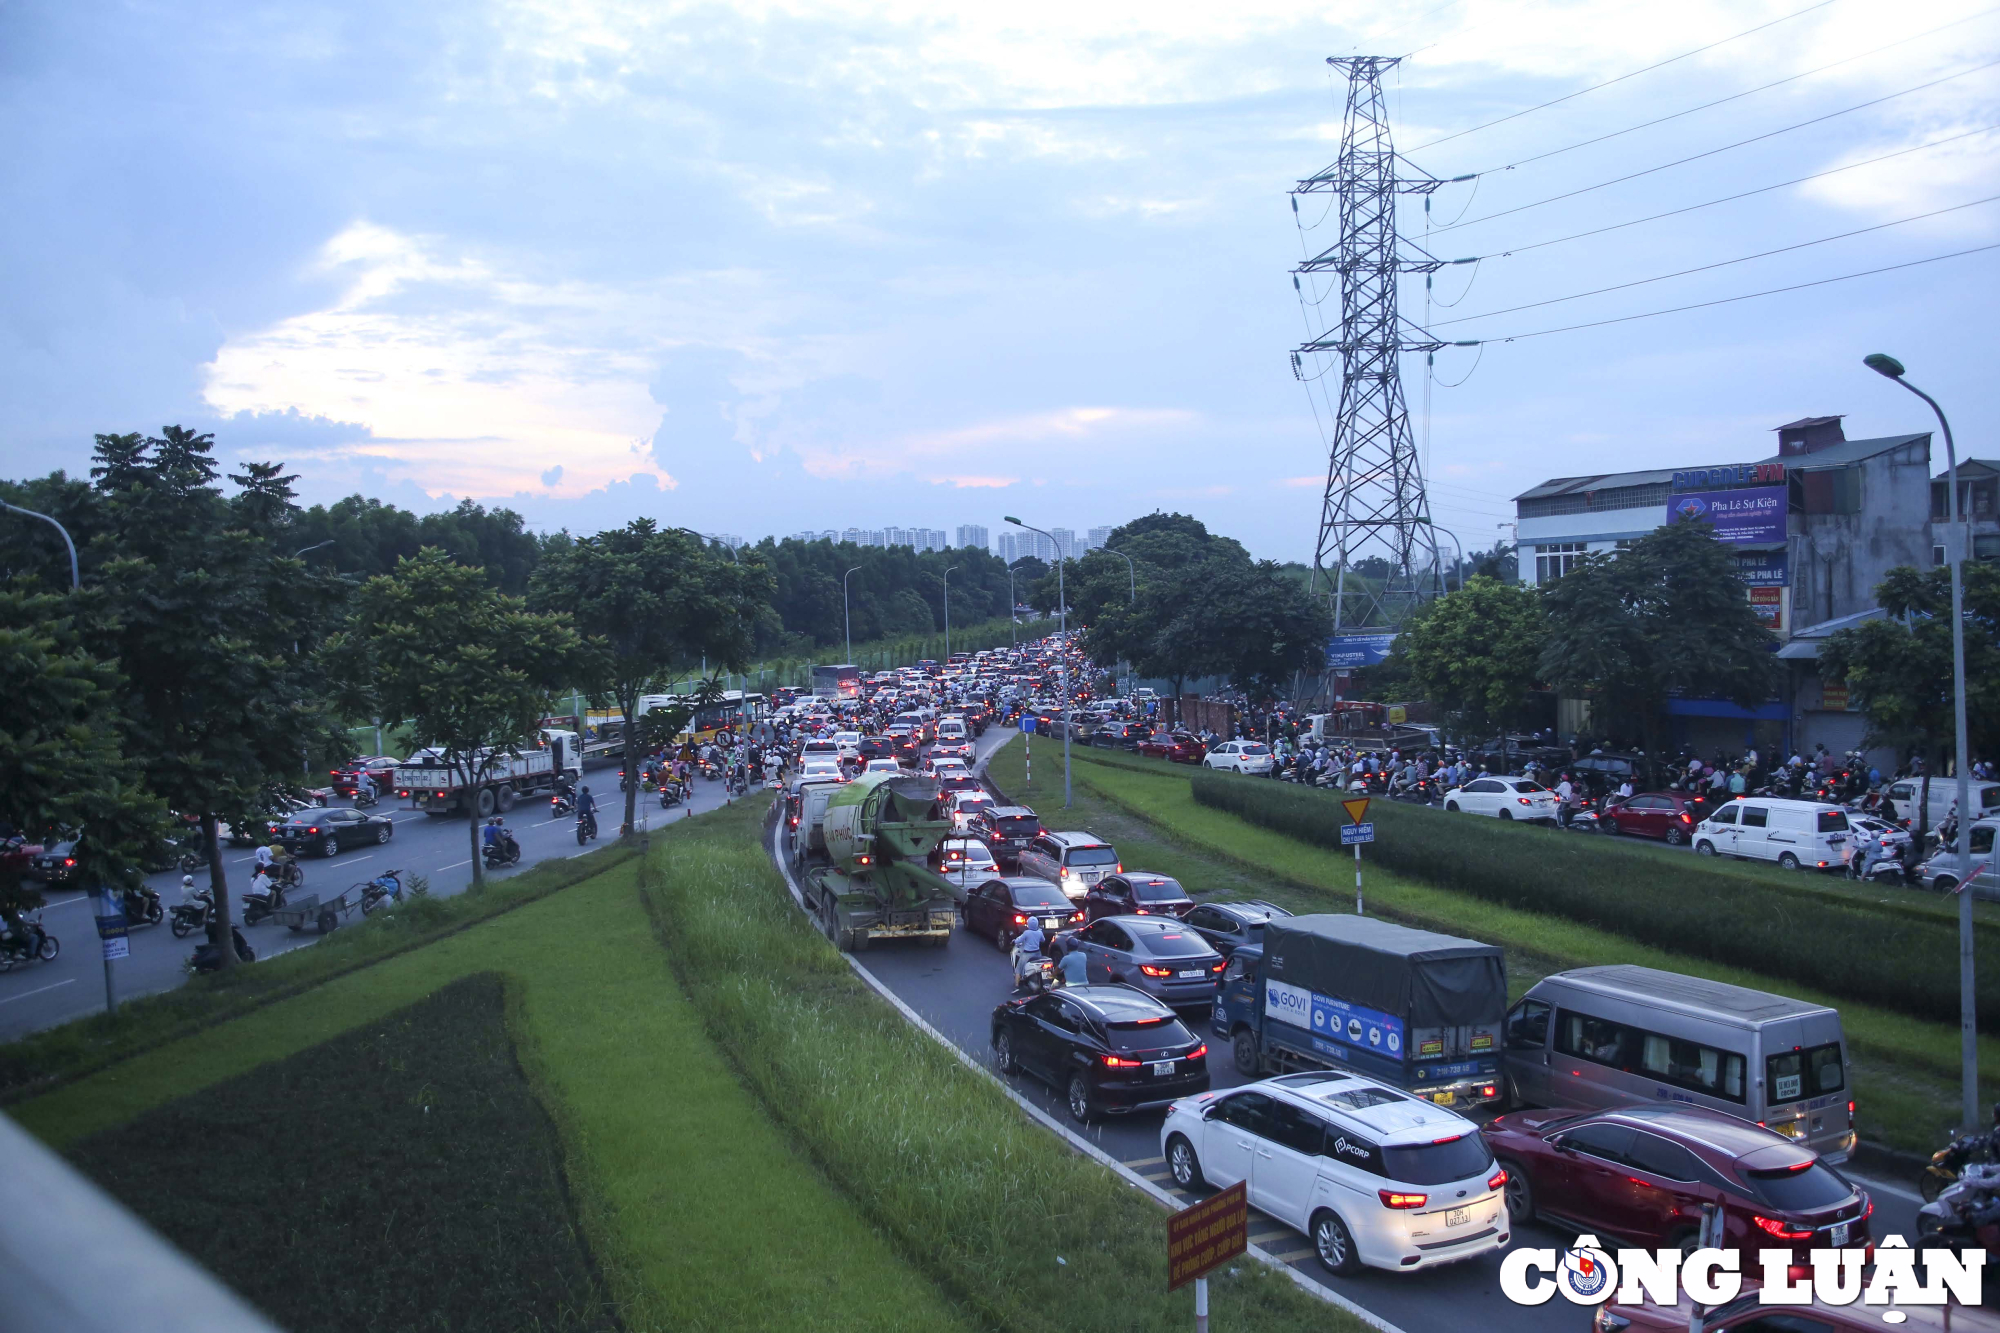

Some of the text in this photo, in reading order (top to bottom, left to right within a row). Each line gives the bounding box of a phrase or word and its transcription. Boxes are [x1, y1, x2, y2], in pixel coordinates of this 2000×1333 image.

[1672, 463, 1784, 489] CUPGOLF.VN
[1711, 498, 1777, 512] Pha Lê Sự Kiện
[1757, 570, 1772, 580] PHA
[1774, 568, 1783, 579] LÊ
[1343, 825, 1371, 836] NGUY HIỂM
[1281, 992, 1306, 1011] GOVI
[1313, 994, 1350, 1011] GOVI FURNITURE
[1346, 1144, 1370, 1158] PCORP
[1454, 1208, 1464, 1218] 30H
[1450, 1215, 1468, 1226] 027.13
[1170, 1241, 1182, 1258] KHU
[1226, 1212, 1236, 1230] QUA
